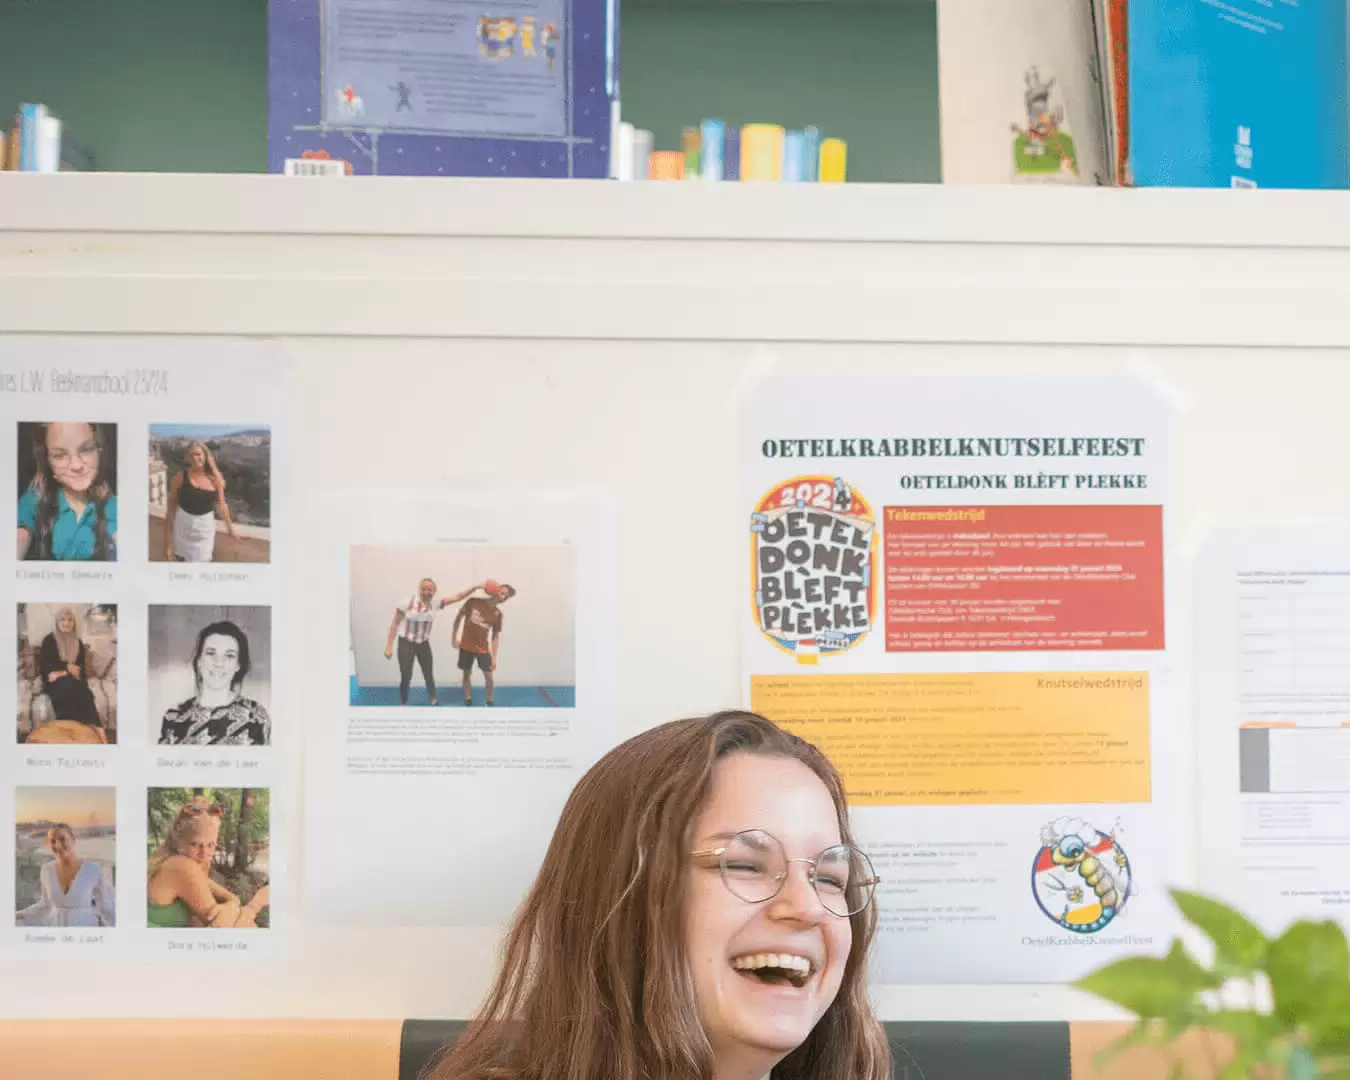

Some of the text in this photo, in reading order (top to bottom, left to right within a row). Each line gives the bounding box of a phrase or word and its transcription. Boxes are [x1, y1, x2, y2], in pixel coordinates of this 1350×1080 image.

[762, 438, 1146, 460] OETELKRABBELKNUTSELFEEST
[900, 471, 1148, 489] OETELDONK BLÈFT PLEKKE
[780, 481, 853, 512] 2024
[888, 508, 986, 523] Tekenwedstrijd
[760, 512, 868, 549] OETEL
[760, 540, 865, 577] DONK
[1037, 677, 1143, 690] Knutselwedstrijd
